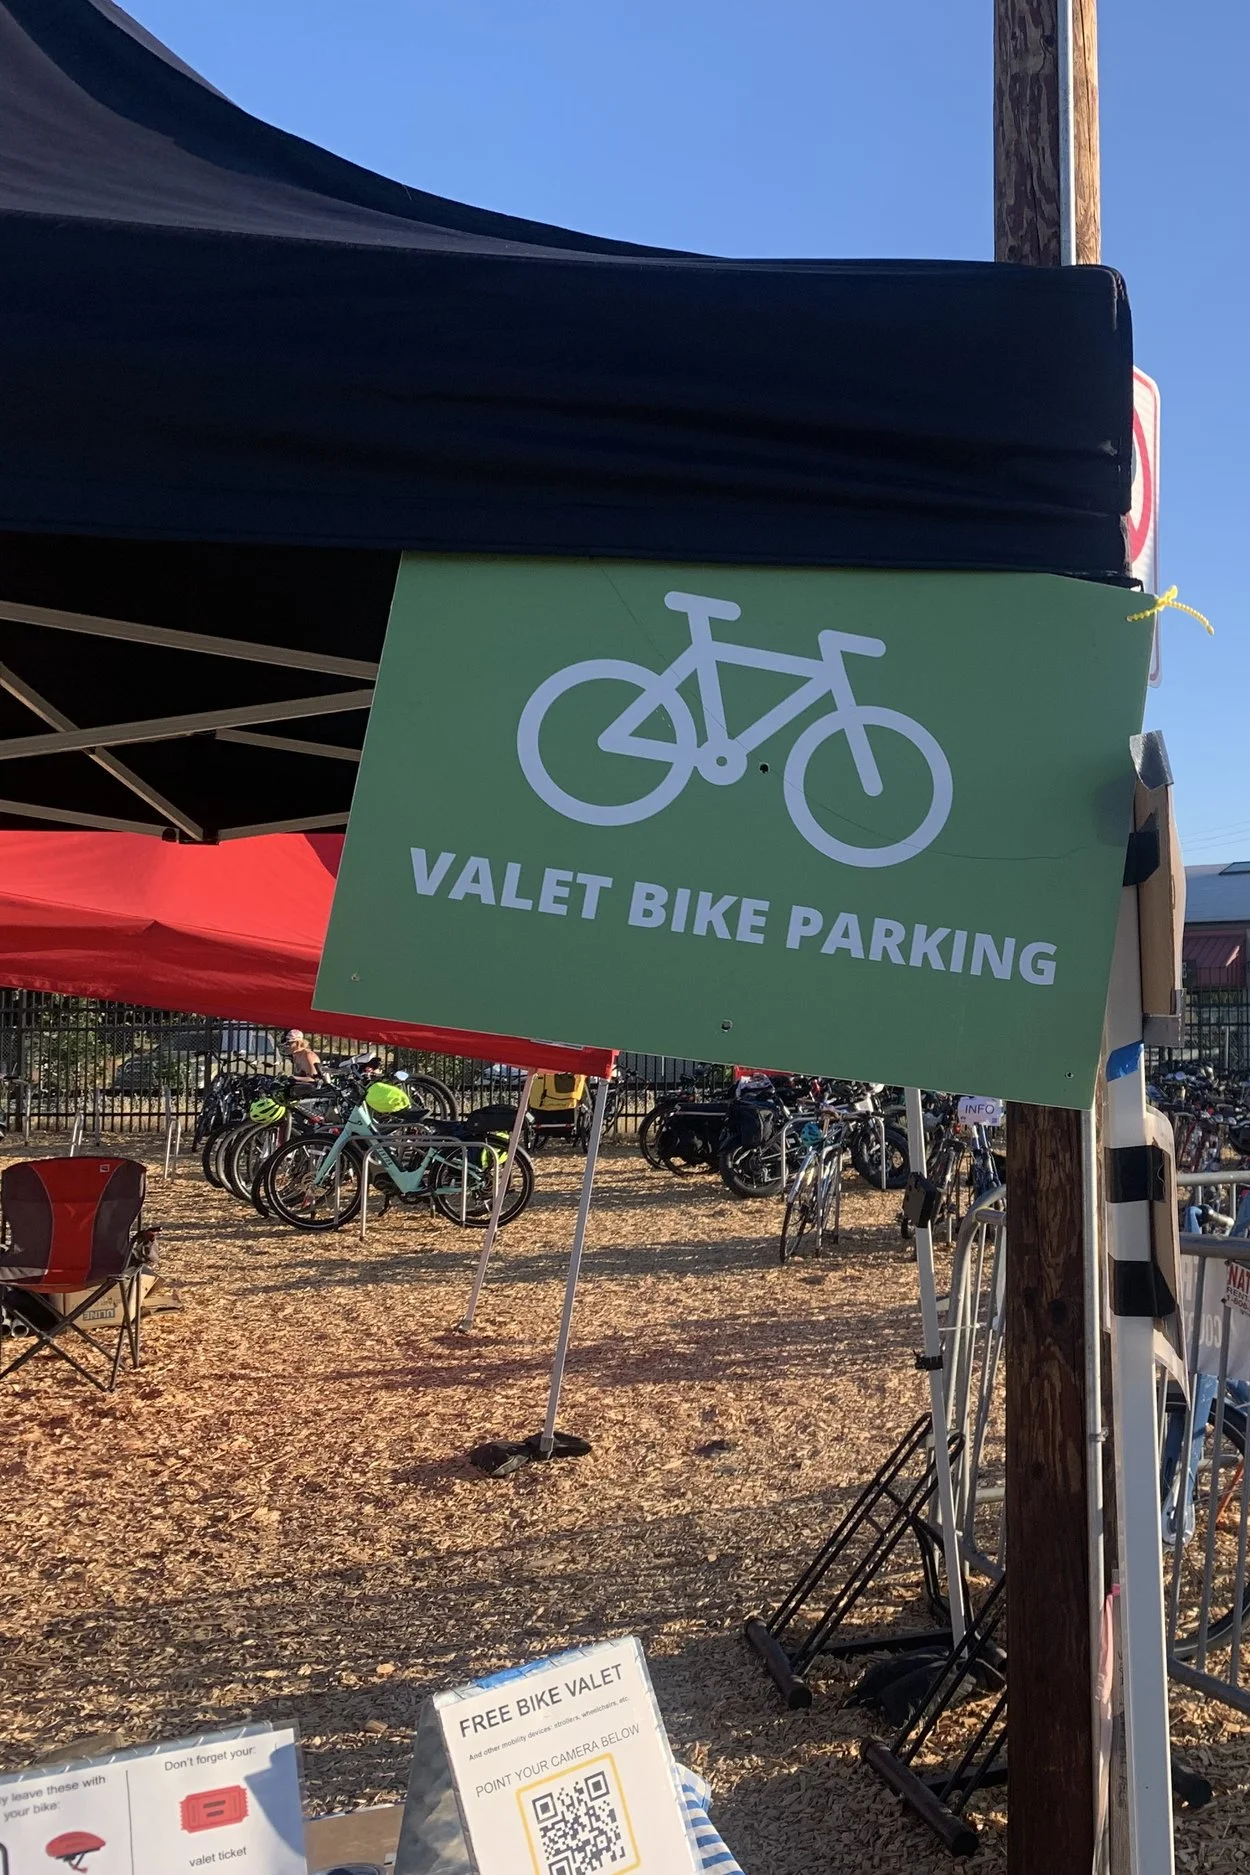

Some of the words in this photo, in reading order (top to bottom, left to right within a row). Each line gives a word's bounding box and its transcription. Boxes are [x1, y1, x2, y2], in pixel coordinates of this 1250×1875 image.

[408, 847, 614, 920] VALET
[627, 880, 771, 946] BIKE
[787, 904, 1059, 986] PARKING
[965, 1104, 995, 1114] INFO
[83, 1309, 115, 1321] ULINE
[459, 1704, 513, 1738] FREE
[516, 1686, 563, 1717] BIKE
[565, 1664, 624, 1698] VALET
[469, 1750, 483, 1761] And
[483, 1745, 500, 1756] other
[501, 1735, 527, 1750] mobility
[527, 1725, 553, 1739] devices:
[554, 1715, 581, 1728] strollers,
[164, 1757, 194, 1771] Don't
[196, 1751, 228, 1764] forget
[230, 1746, 256, 1759] your:
[475, 1774, 512, 1798] POINT
[515, 1759, 549, 1783] YOUR
[550, 1740, 600, 1768] CAMERA
[601, 1724, 640, 1748] BELOW
[0, 1795, 8, 1807] y
[11, 1789, 44, 1802] leave
[47, 1782, 79, 1796] these
[82, 1775, 106, 1788] with
[3, 1807, 30, 1822] your
[33, 1800, 60, 1815] bike:
[189, 1853, 216, 1867] valet
[218, 1846, 247, 1861] ticket
